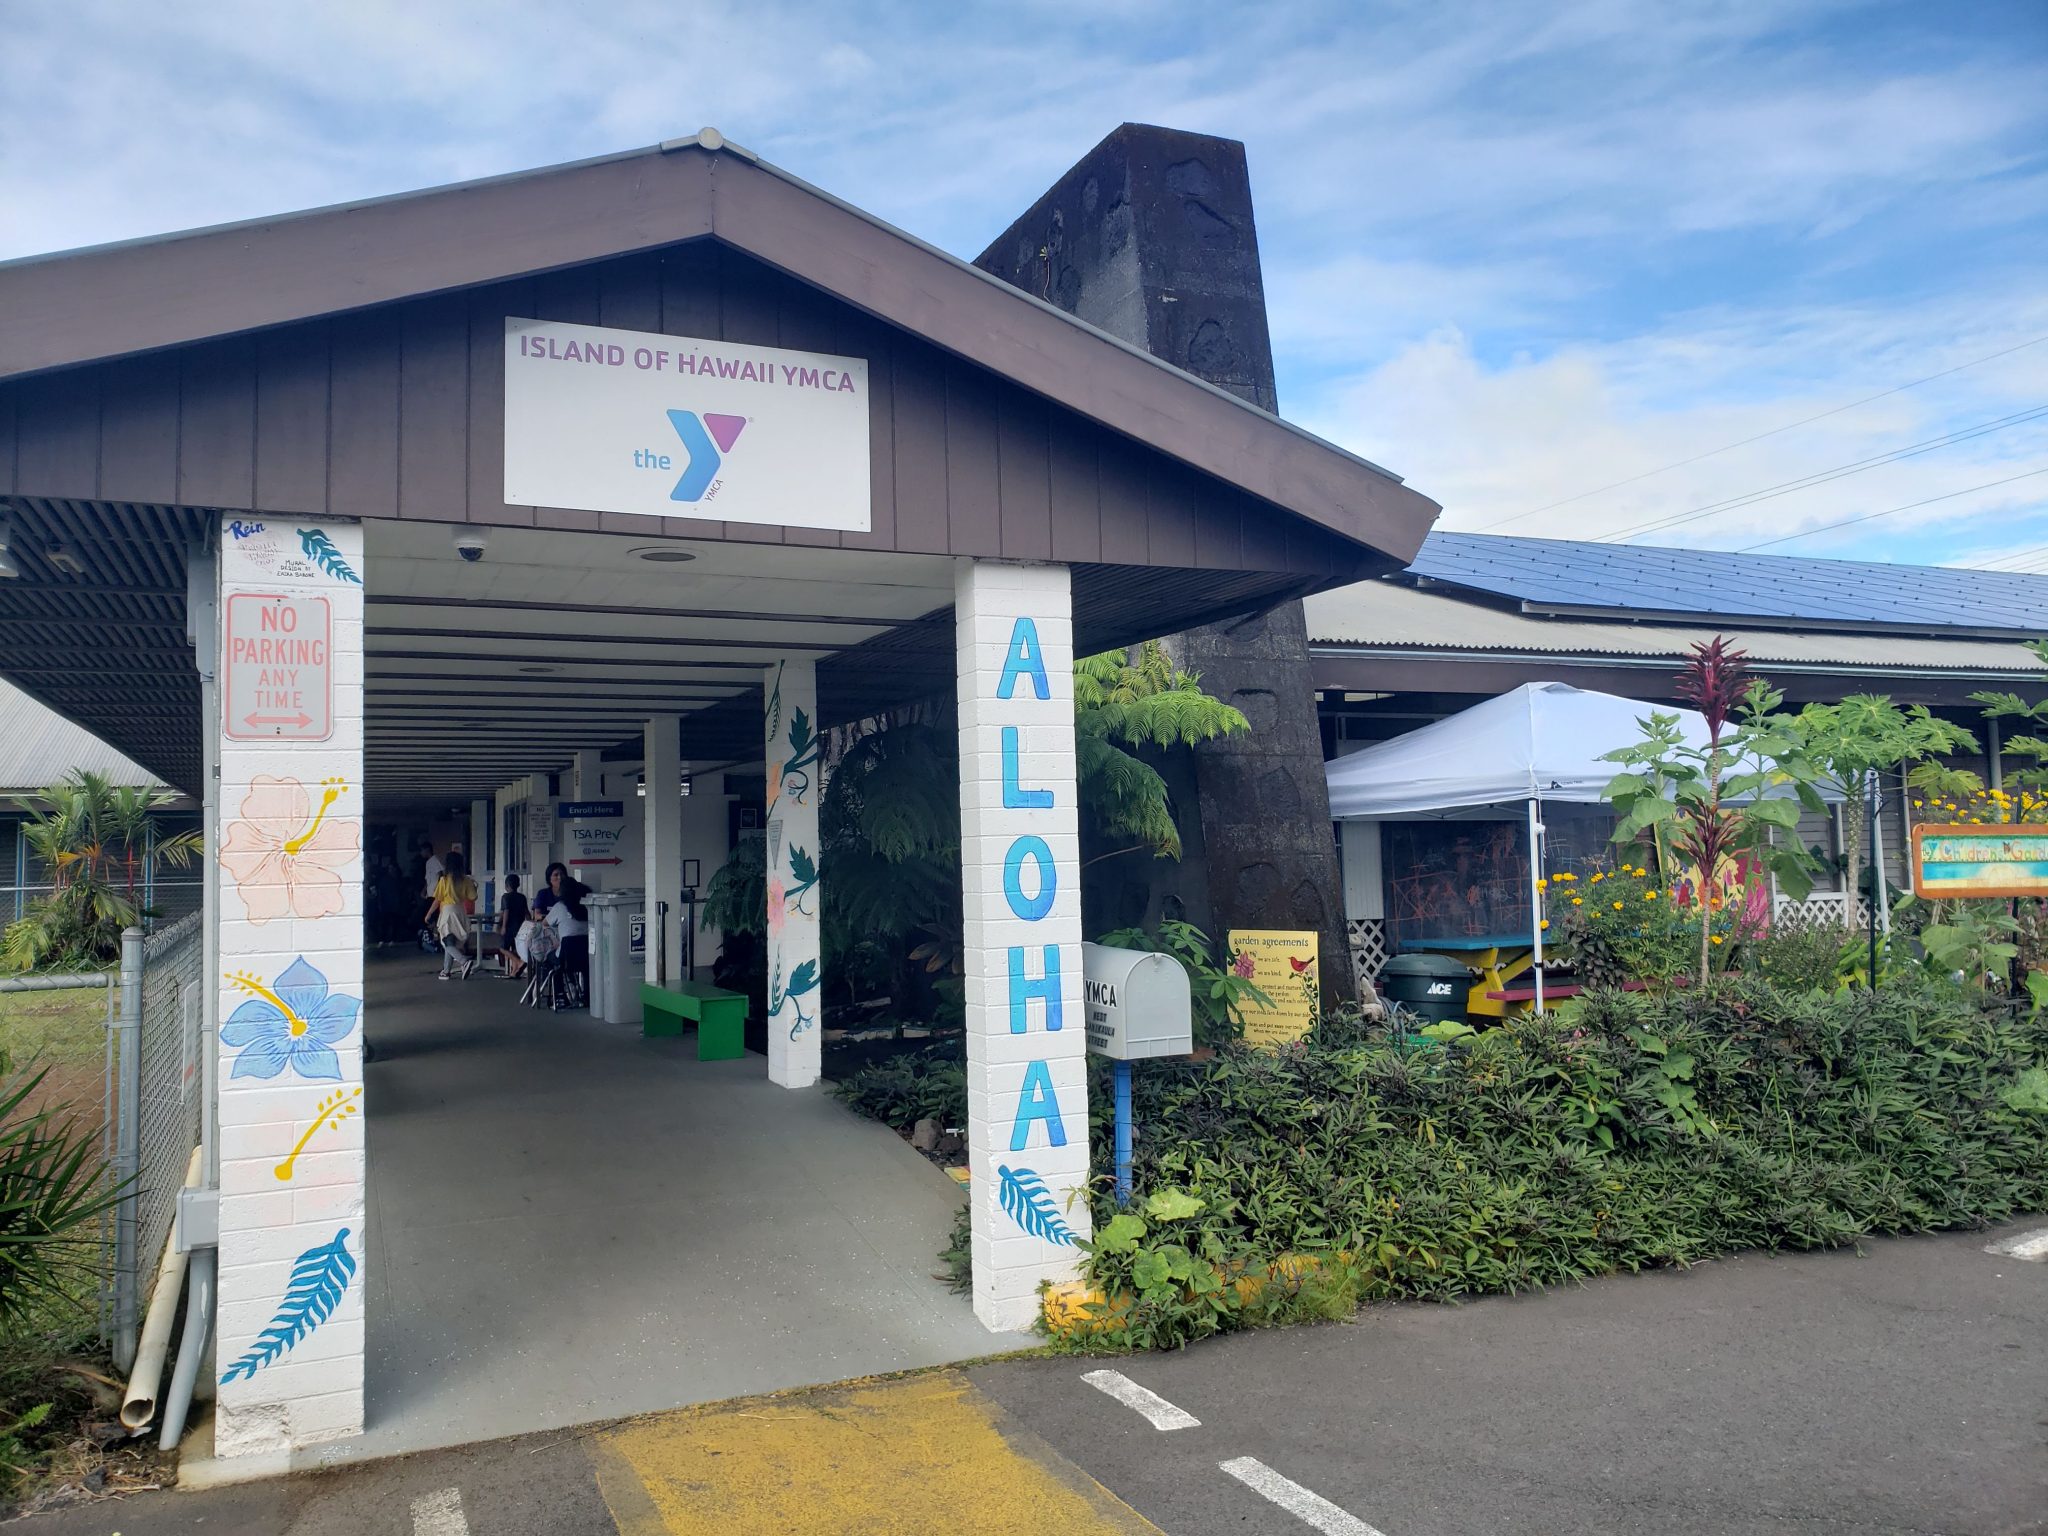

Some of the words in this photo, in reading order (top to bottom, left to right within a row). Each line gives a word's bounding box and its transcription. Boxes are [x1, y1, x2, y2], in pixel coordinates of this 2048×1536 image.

[520, 335, 625, 367] ISLAND
[634, 348, 670, 372] OF
[678, 352, 774, 384] HAWAII
[781, 363, 856, 393] YMCA
[633, 448, 671, 471] the
[704, 478, 724, 502] YMCA
[229, 520, 266, 540] Rein
[261, 606, 297, 633] NO
[233, 637, 324, 666] PARKING
[258, 669, 299, 687] ANY
[255, 690, 304, 709] TIME
[572, 829, 592, 839] TSA
[996, 617, 1068, 1152] ALOHA
[1234, 935, 1259, 947] garden
[1262, 938, 1309, 948] agreements
[1085, 980, 1117, 1007] YMCA
[1427, 981, 1453, 995] ACE
